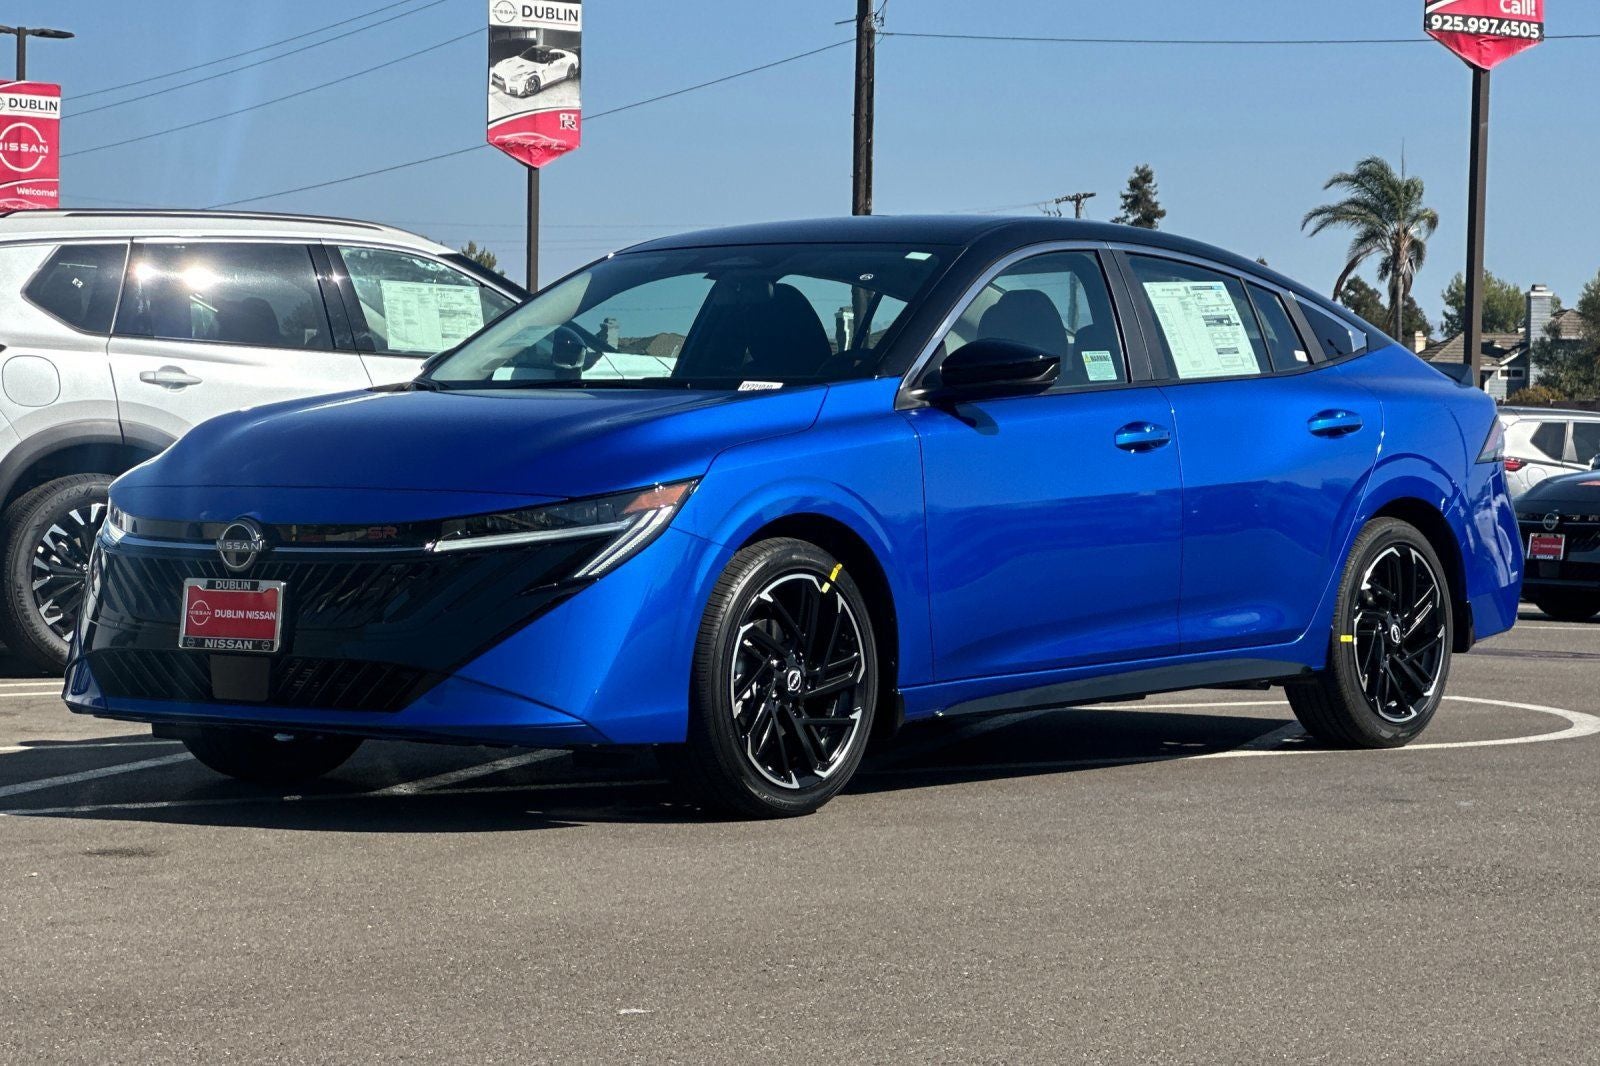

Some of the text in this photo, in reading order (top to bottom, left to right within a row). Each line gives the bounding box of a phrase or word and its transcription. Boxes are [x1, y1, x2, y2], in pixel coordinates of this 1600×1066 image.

[522, 5, 579, 22] DUBLIN
[1500, 0, 1536, 16] Call!
[1431, 15, 1540, 38] 925.997.4505
[9, 97, 58, 111] DUBLIN
[0, 142, 48, 154] ISSAN
[17, 186, 57, 197] Welcome!
[367, 526, 398, 540] SR
[216, 541, 261, 551] NISSAN
[215, 580, 251, 590] DUBLIN
[214, 609, 276, 620] DUBLIN NISSAN
[204, 638, 253, 649] NISSAN
